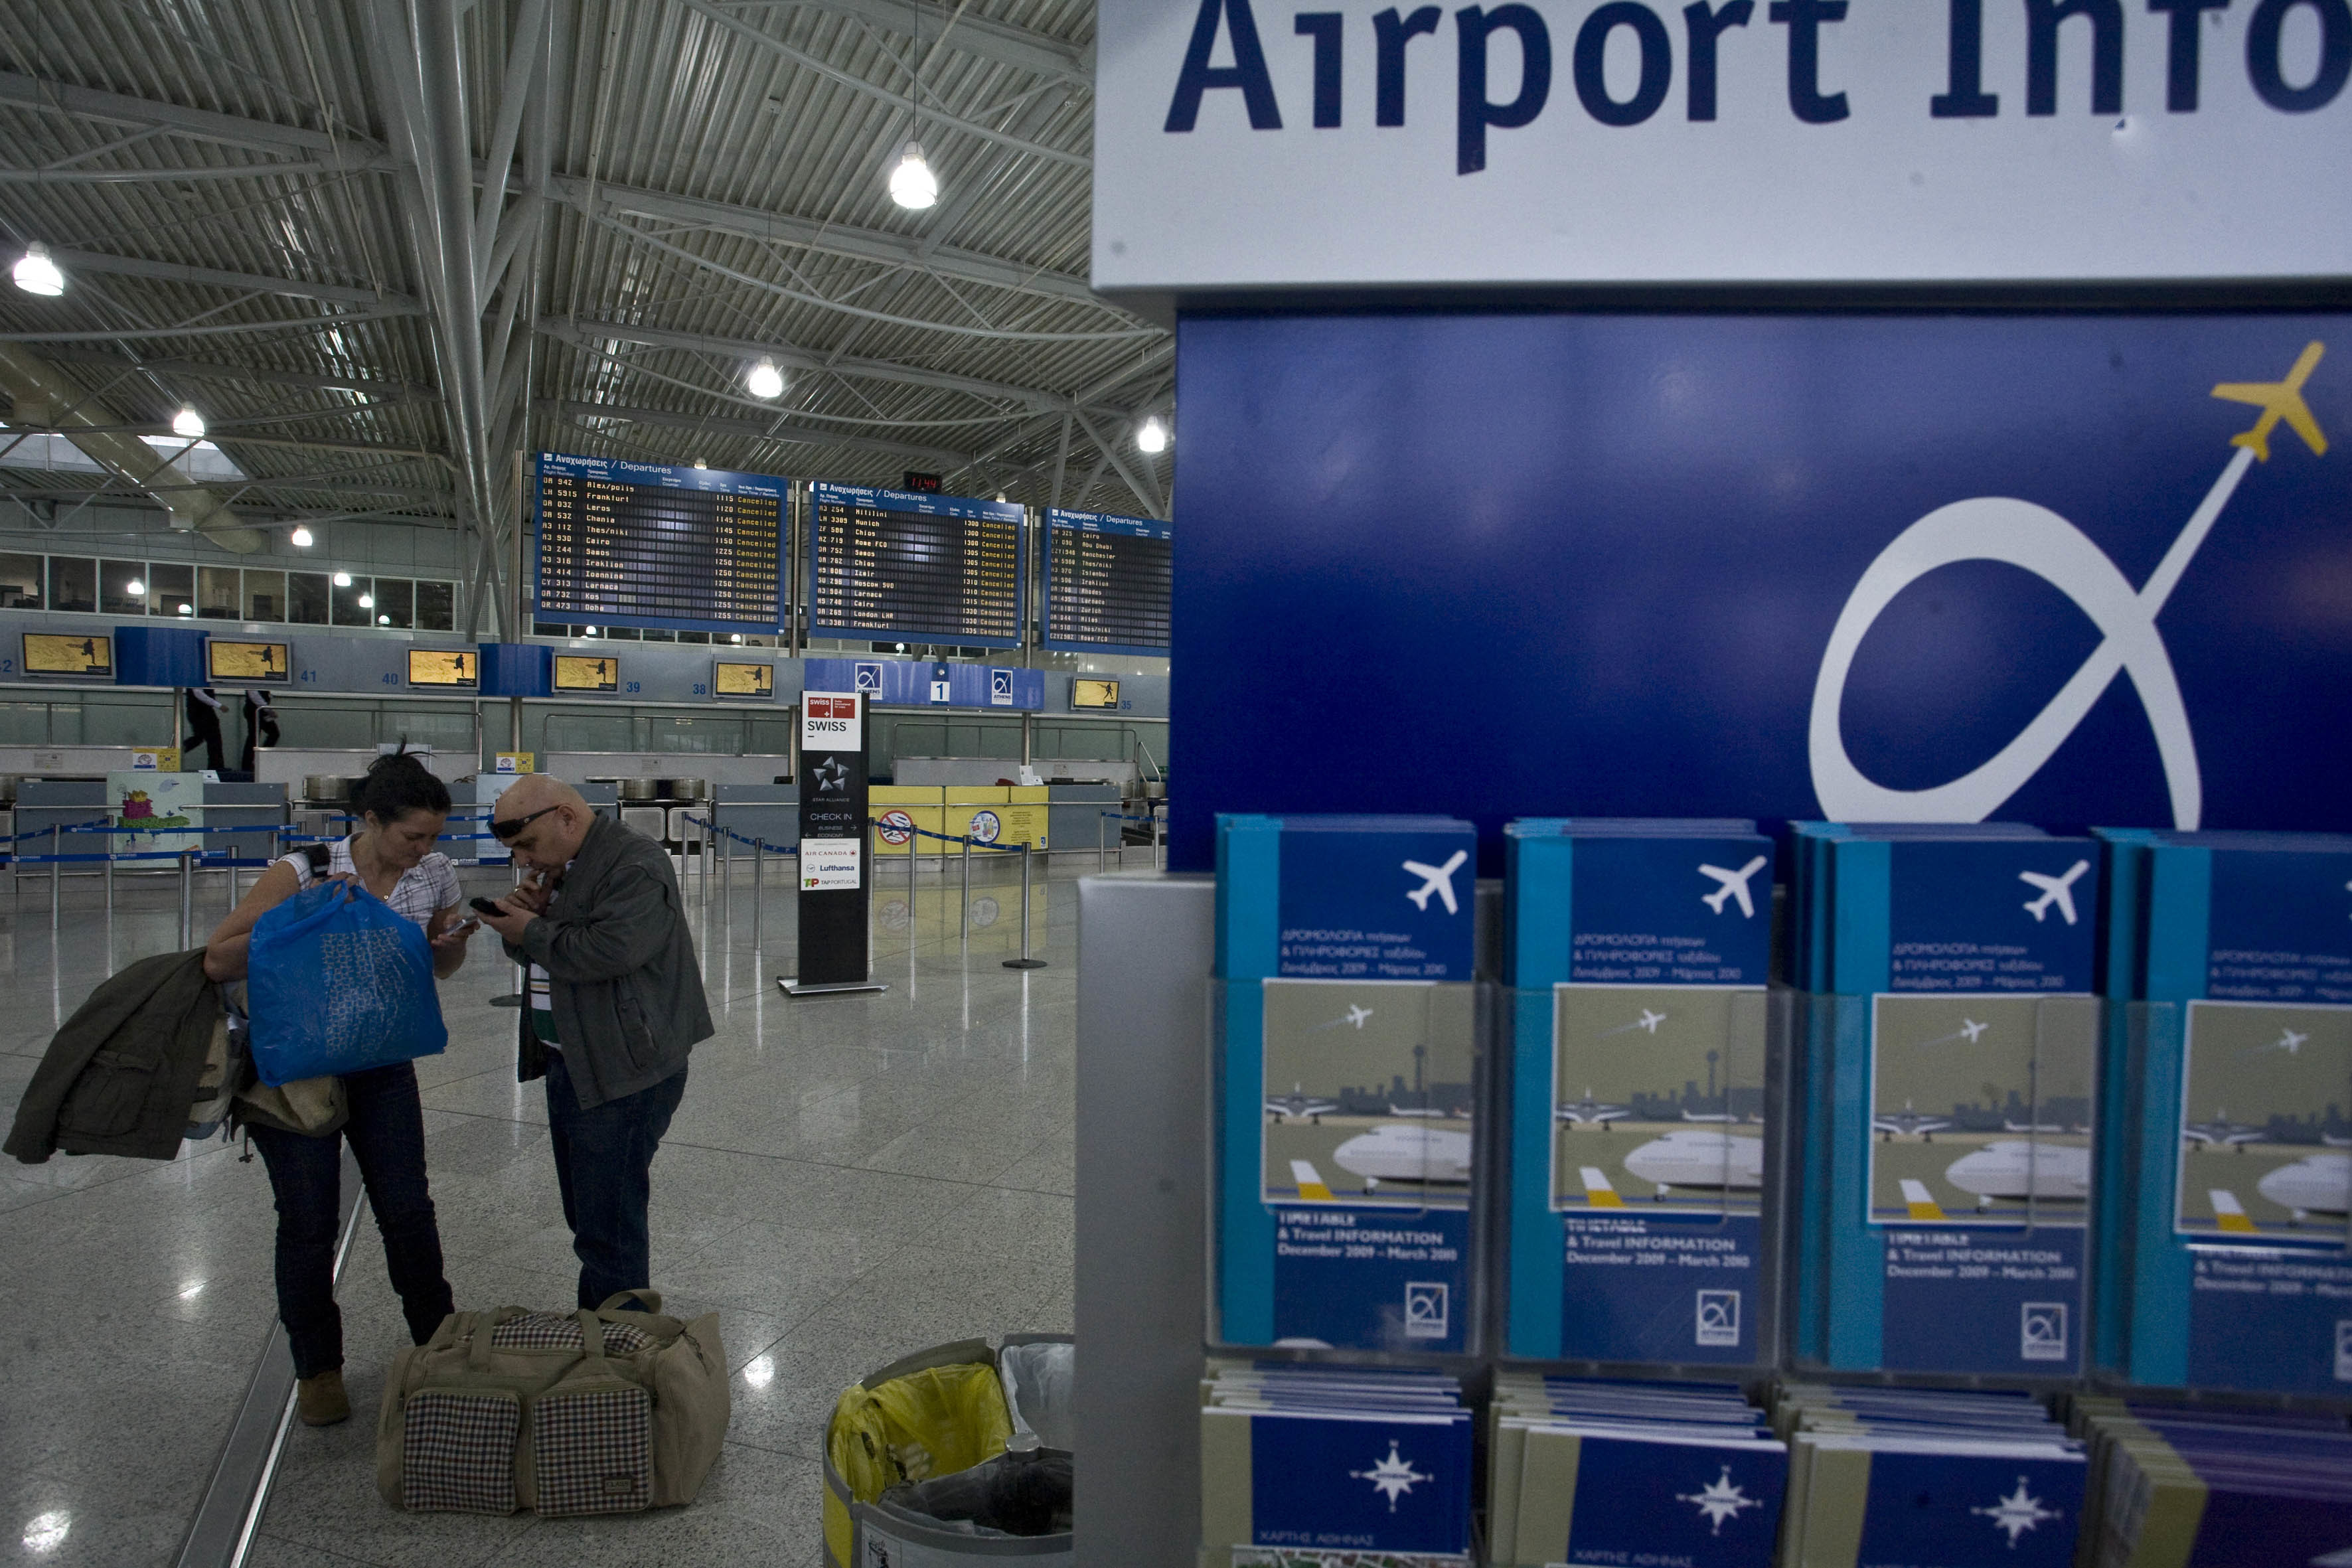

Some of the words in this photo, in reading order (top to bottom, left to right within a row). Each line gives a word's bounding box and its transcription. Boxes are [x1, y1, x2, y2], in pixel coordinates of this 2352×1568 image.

[1164, 0, 1851, 176] Airport
[556, 455, 607, 468] Αναχωρήσεις
[621, 461, 671, 475] Departures
[588, 482, 634, 492] Alex/polis
[738, 497, 776, 506] Cancelled
[830, 484, 873, 497] Αναχωρήσεις
[884, 490, 927, 502] Departures
[587, 493, 629, 502] Frankfurt
[738, 508, 776, 516] Cancelled
[738, 518, 776, 527] Cancelled
[1061, 510, 1097, 521] Αναχωρήσεις
[1106, 514, 1142, 526] Departures
[738, 529, 775, 538] Cancelled
[737, 539, 775, 548] Cancelled
[737, 550, 775, 558] Cancelled
[586, 560, 623, 568] Iraklion
[737, 560, 775, 569] Cancelled
[300, 670, 316, 682] 41
[382, 673, 398, 685] 40
[627, 682, 640, 692] 39
[693, 684, 706, 694] 38
[936, 682, 943, 700] 1
[1122, 700, 1131, 710] 35
[808, 721, 846, 732] SWISS
[1293, 1227, 1332, 1241] Travel
[1334, 1229, 1444, 1245] INFORMATION
[1582, 1235, 1621, 1249] Travel
[1625, 1237, 1736, 1253] INFORMATION
[1277, 1243, 1343, 1258] December
[1566, 1251, 1632, 1265] December
